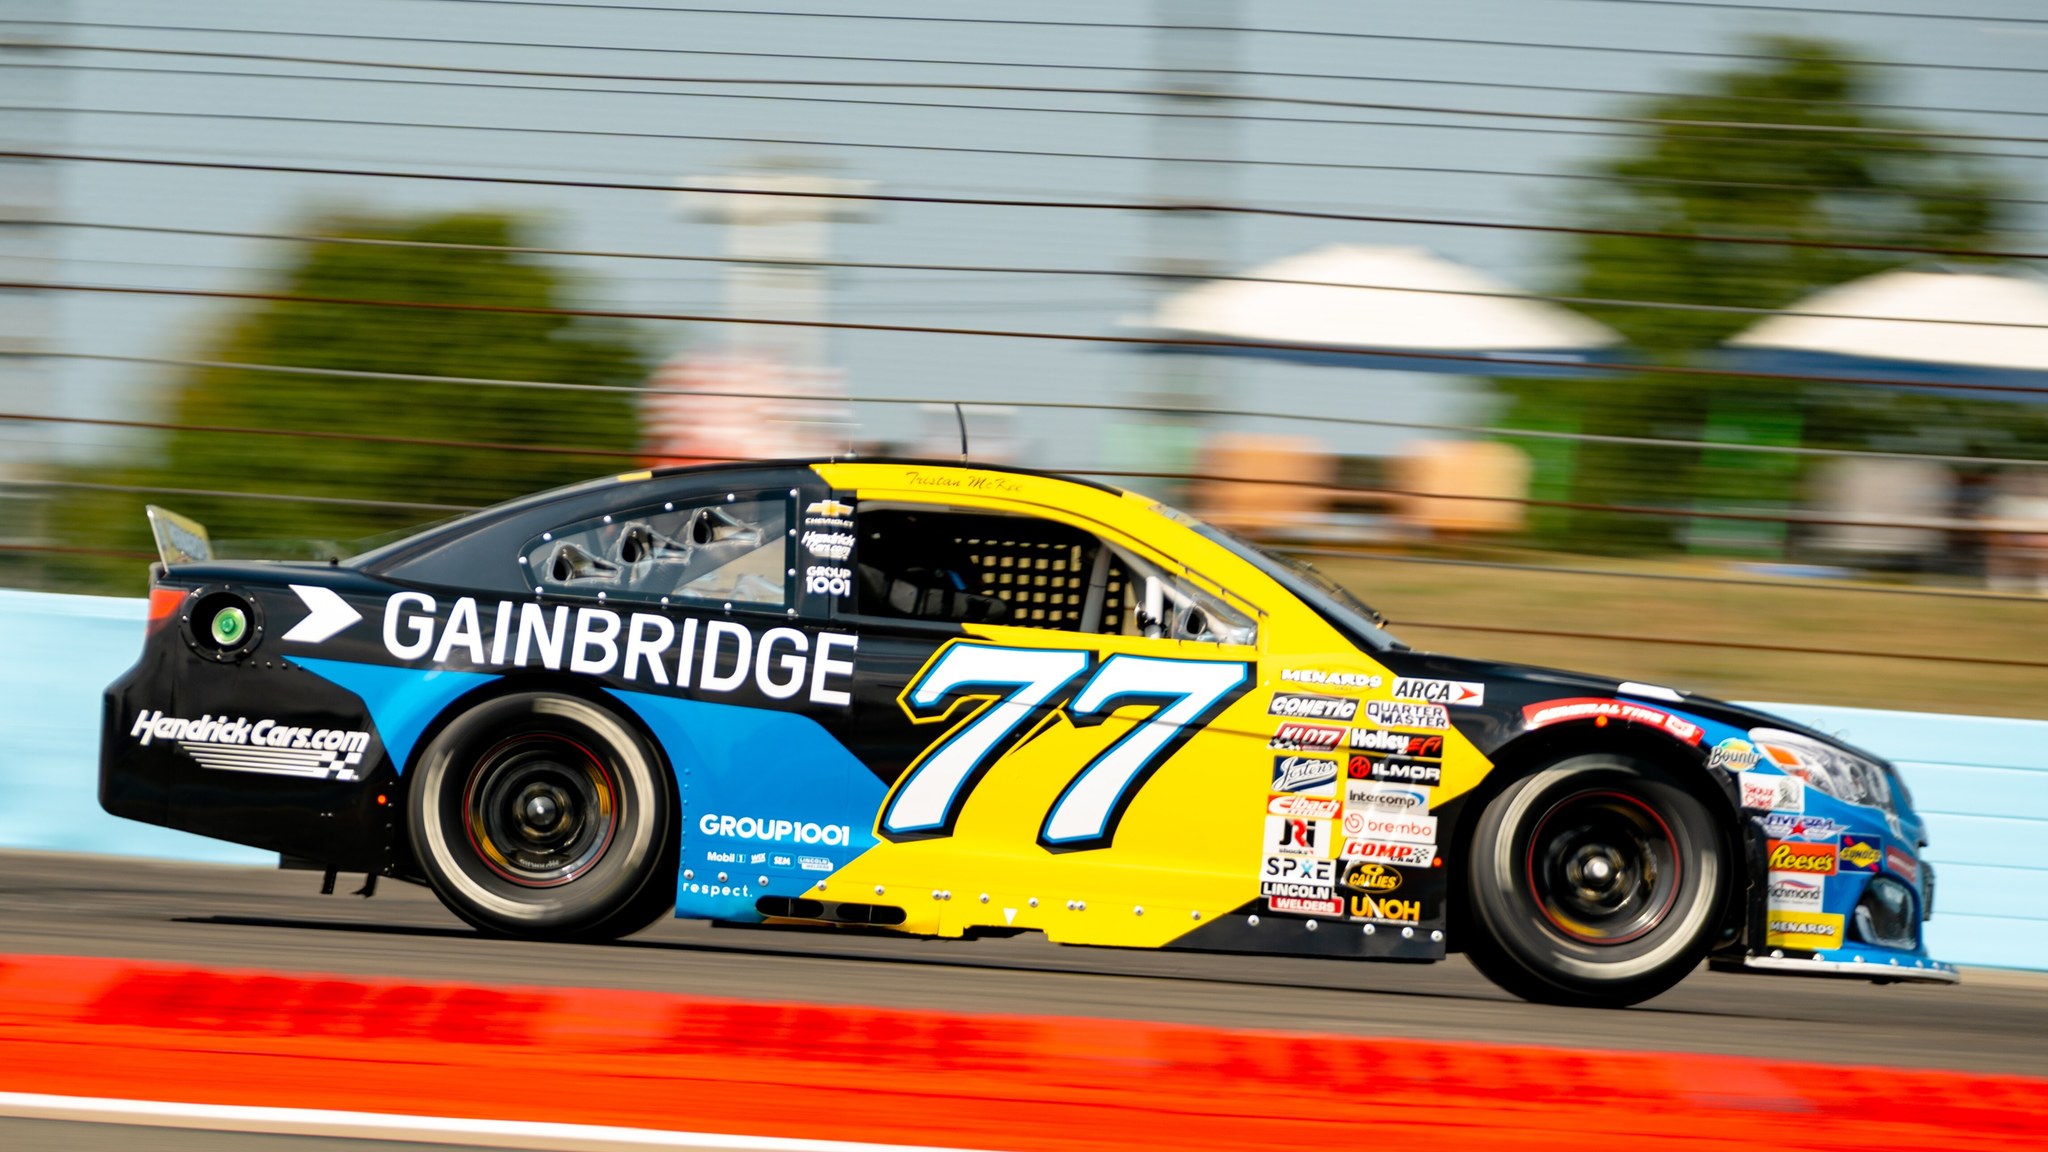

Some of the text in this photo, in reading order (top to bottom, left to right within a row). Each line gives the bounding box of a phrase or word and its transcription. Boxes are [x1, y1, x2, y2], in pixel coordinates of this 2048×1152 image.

[805, 517, 854, 528] CHEVROLET
[801, 531, 856, 548] Hendrick
[806, 566, 852, 579] GROUP
[806, 576, 851, 598] 1001
[383, 591, 858, 706] GAINBRIDGE
[1281, 669, 1382, 688] MENARDS
[1396, 680, 1450, 700] ARCA
[1271, 697, 1357, 718] COMETIC
[1367, 702, 1443, 717] QUARTER
[1533, 703, 1665, 723] GENERAL TIRE
[1380, 716, 1447, 728] MASTER
[1281, 726, 1340, 746] KLOTZ
[1351, 728, 1409, 754] Holley
[880, 642, 1257, 855] 77
[1707, 746, 1761, 769] Bounty
[1272, 756, 1338, 792] Jostens
[1372, 763, 1440, 780] ILMOR
[1268, 796, 1341, 815] Eibach
[1349, 790, 1416, 808] Intercomp
[699, 813, 850, 847] GROUP1001
[1368, 819, 1432, 837] brembo
[707, 851, 735, 863] Mobil
[1347, 842, 1413, 858] COMP
[1769, 844, 1834, 871] Reese's
[774, 856, 791, 866] SEM
[683, 882, 754, 897] respect.
[1349, 873, 1397, 888] CALLIES
[1263, 882, 1330, 900] LINCOLN
[1276, 897, 1336, 912] WELDERS
[1351, 896, 1420, 921] UNOH
[1770, 921, 1835, 936] MENARDS
